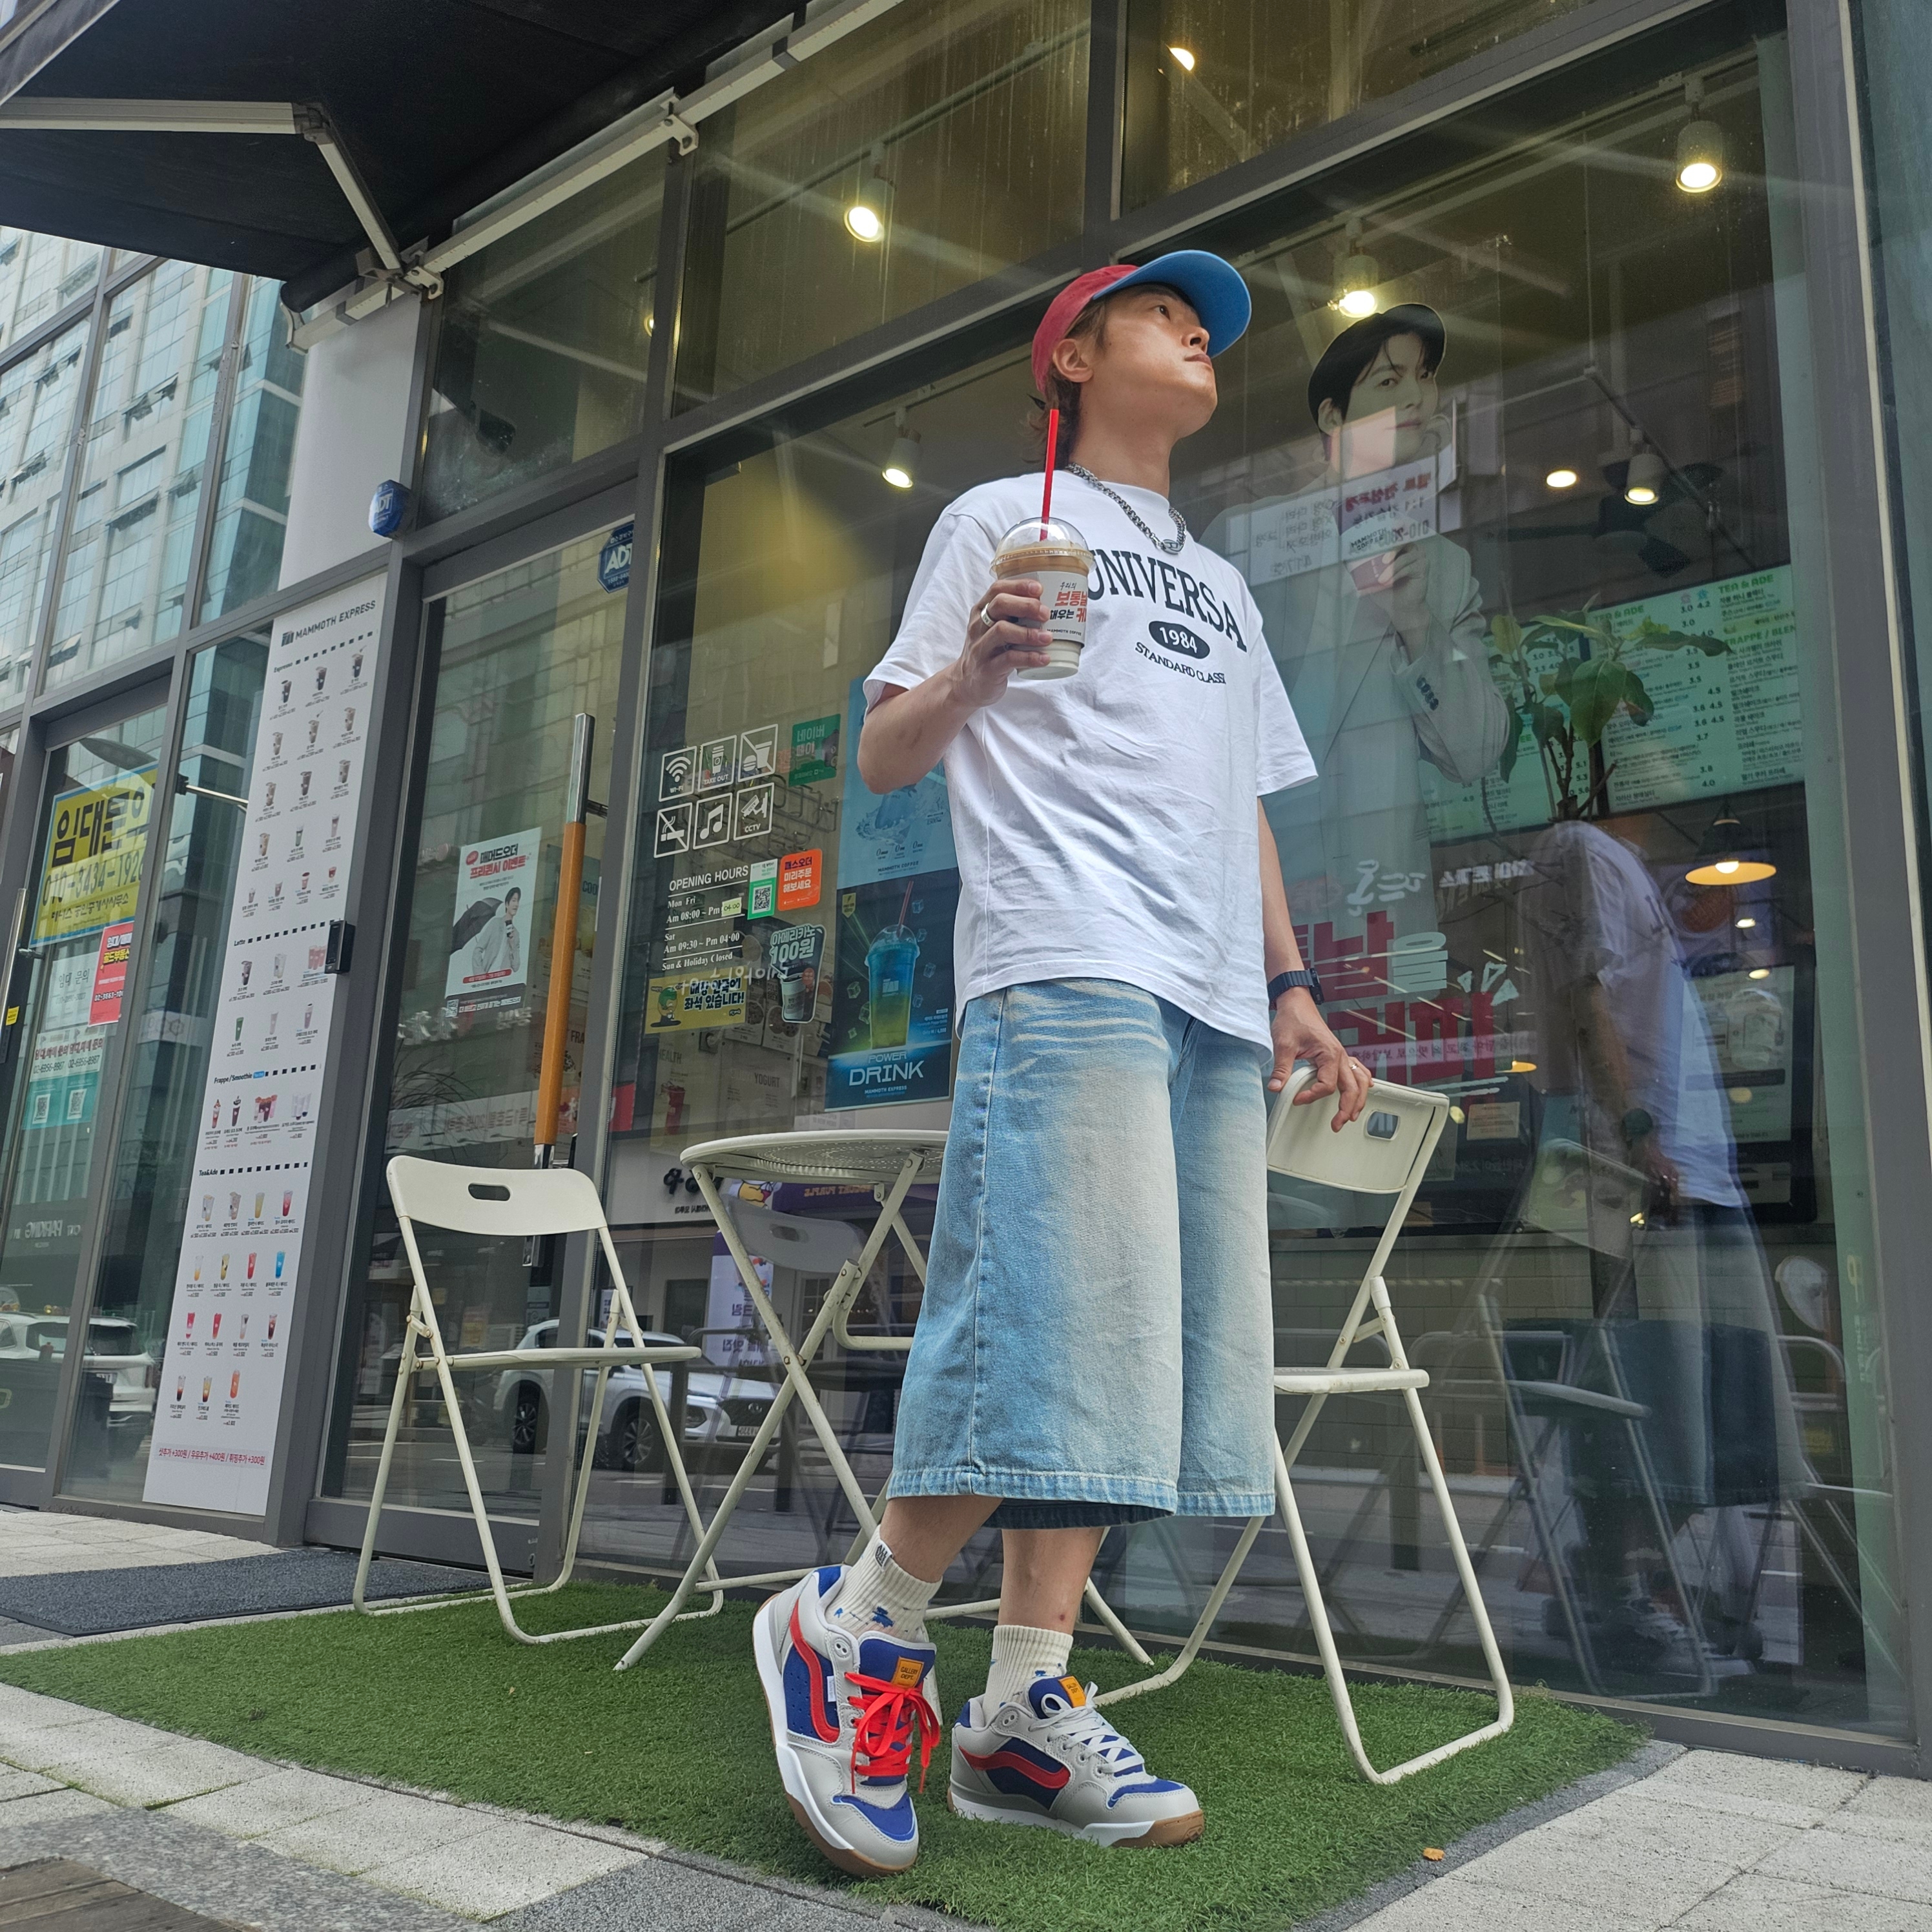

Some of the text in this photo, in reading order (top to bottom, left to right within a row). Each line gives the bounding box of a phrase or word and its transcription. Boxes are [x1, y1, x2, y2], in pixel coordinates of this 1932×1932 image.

[1351, 528, 1386, 548] MAMMOTH
[1357, 535, 1384, 551] COFFEE
[604, 543, 633, 574] ADT
[1060, 582, 1077, 591] 우리의
[1718, 584, 1739, 593] TEA
[1751, 574, 1774, 586] ADE
[1624, 606, 1643, 615] ADE
[295, 600, 375, 640] MAMMOTH EXPRESS
[1160, 626, 1198, 653] 1984
[274, 662, 293, 673] Espresso
[1135, 642, 1195, 677] STANDARD
[797, 724, 825, 743] 네이버
[745, 823, 761, 833] CCTV
[502, 855, 526, 871] 이벤트
[785, 857, 812, 870] 패스오더
[878, 863, 900, 872] MAMMOTH
[669, 873, 712, 892] OPENING
[714, 865, 748, 882] HOURS
[784, 867, 812, 881] 미리주문
[783, 879, 811, 892] 해보세요
[667, 896, 696, 909] Mon Fri
[723, 902, 740, 912] 04:00
[666, 914, 679, 924] Am
[681, 910, 700, 921] 08:00
[708, 907, 720, 916] Pm
[663, 945, 677, 954] Am
[678, 941, 698, 951] 09:30
[706, 938, 718, 947] Pm
[719, 932, 739, 943] 04:00
[664, 933, 675, 941] Sat
[772, 926, 816, 945] 아메리카노
[771, 937, 816, 964] 100원
[662, 962, 674, 971] Sun
[684, 957, 708, 968] Holiday
[711, 952, 733, 962] Closed
[59, 972, 72, 988] 임대
[75, 969, 90, 984] 문의
[690, 983, 709, 996] 매장
[712, 978, 741, 994] 안쪽에
[684, 992, 745, 1011] 좌석 있습니다!
[868, 1051, 907, 1064] POWER
[754, 1072, 780, 1087] YOGURT
[849, 1060, 924, 1086] DRINK
[191, 1450, 209, 1461] 우유추가
[209, 1452, 225, 1462] +400원
[229, 1454, 247, 1464] 휘핑추가
[248, 1455, 265, 1466] +300원
[900, 1667, 919, 1675] GALLERY
